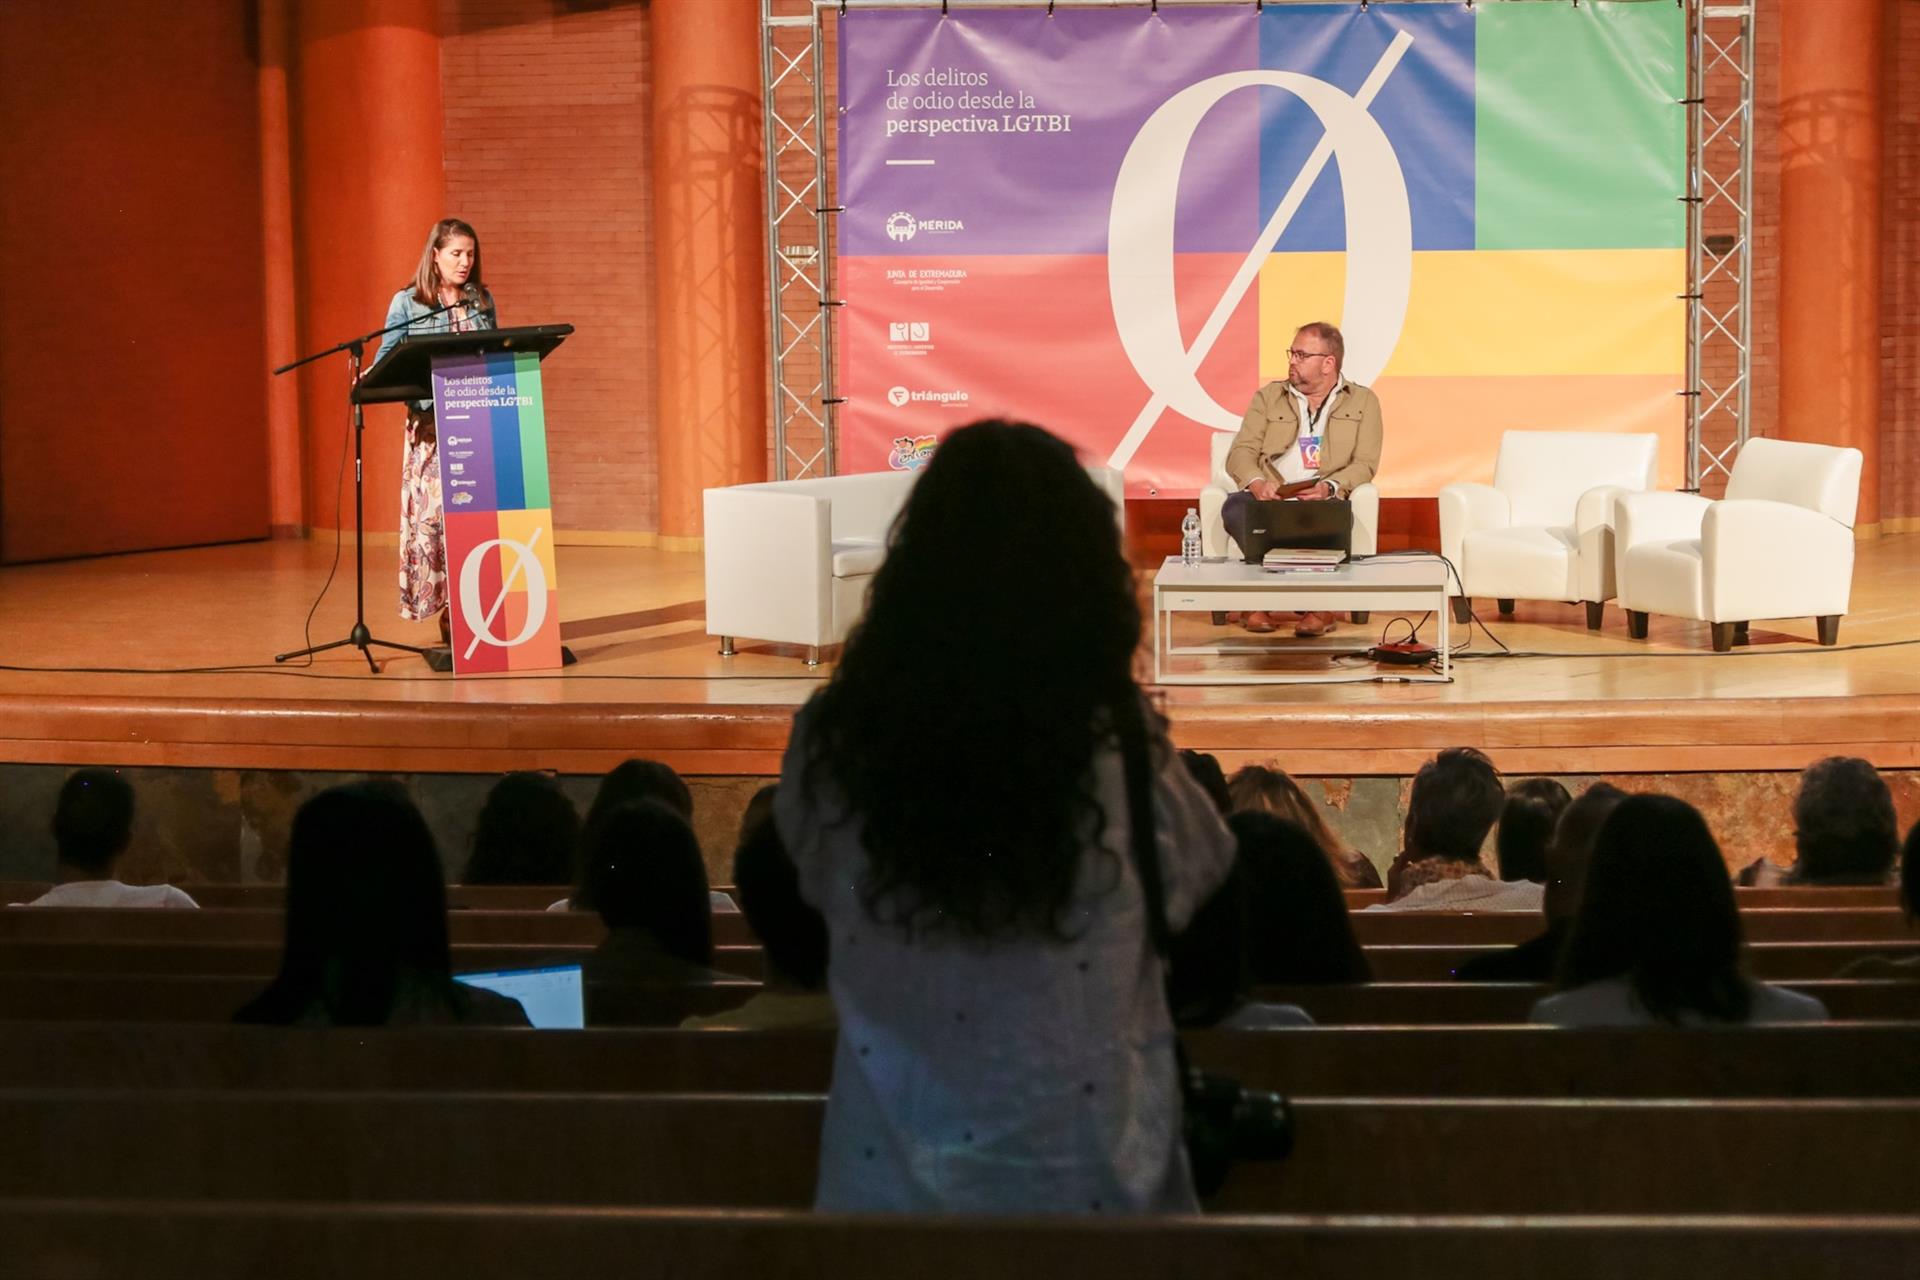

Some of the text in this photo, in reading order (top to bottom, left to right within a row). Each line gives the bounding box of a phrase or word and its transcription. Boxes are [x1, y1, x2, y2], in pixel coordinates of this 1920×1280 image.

[886, 68, 989, 87] Los delitos
[886, 90, 1036, 110] de odio desde la
[886, 114, 1071, 137] perspectiva LGTBI
[444, 375, 493, 386] Los delitos
[444, 384, 516, 397] de odio desde la
[911, 389, 969, 403] triángulo
[445, 396, 534, 411] perspectiva LGTBI
